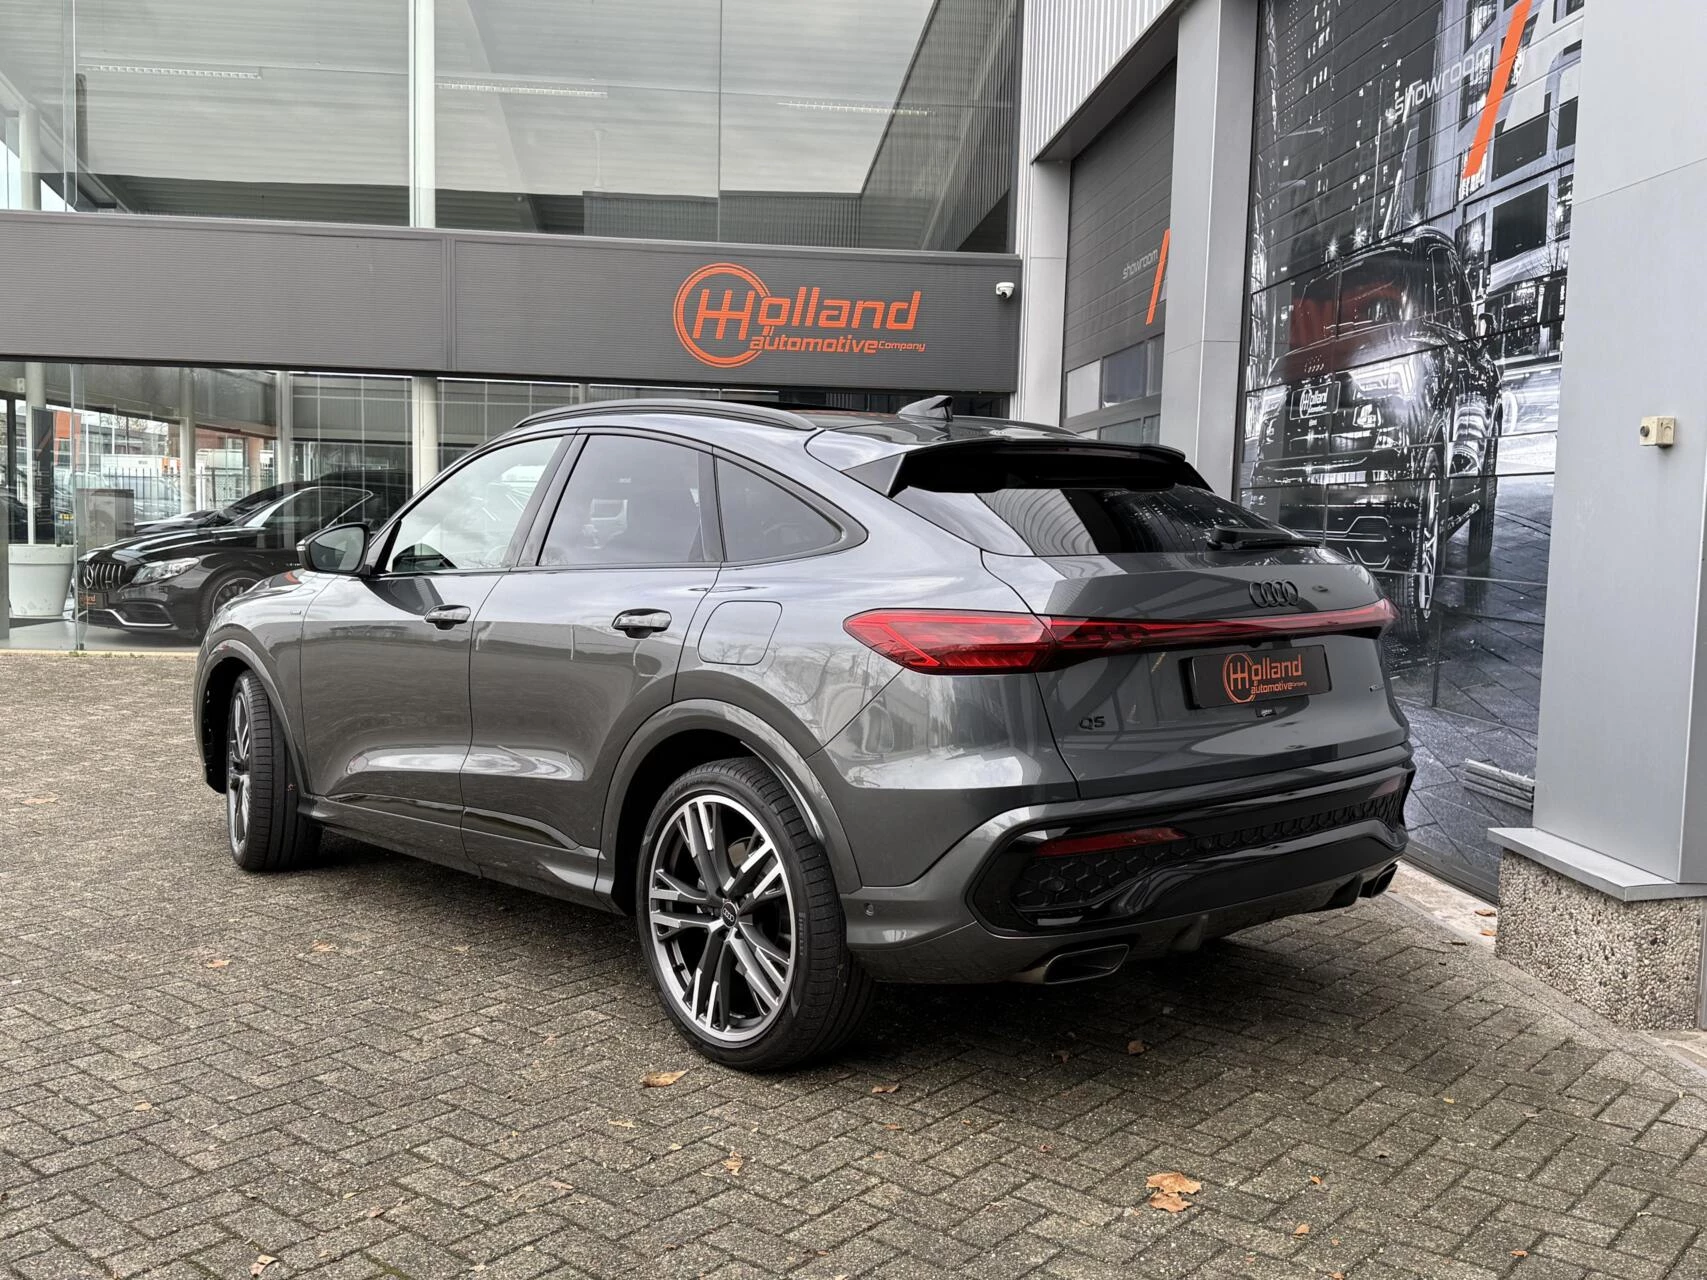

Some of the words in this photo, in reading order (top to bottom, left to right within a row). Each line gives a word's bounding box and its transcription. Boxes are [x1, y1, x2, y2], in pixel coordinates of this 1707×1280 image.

[1394, 44, 1492, 116] showroom
[1122, 249, 1158, 280] showroom
[692, 286, 922, 340] Holland
[750, 334, 878, 354] automotive
[1229, 655, 1302, 690] Holland
[1251, 681, 1292, 694] automotive
[1079, 716, 1105, 730] Q5
